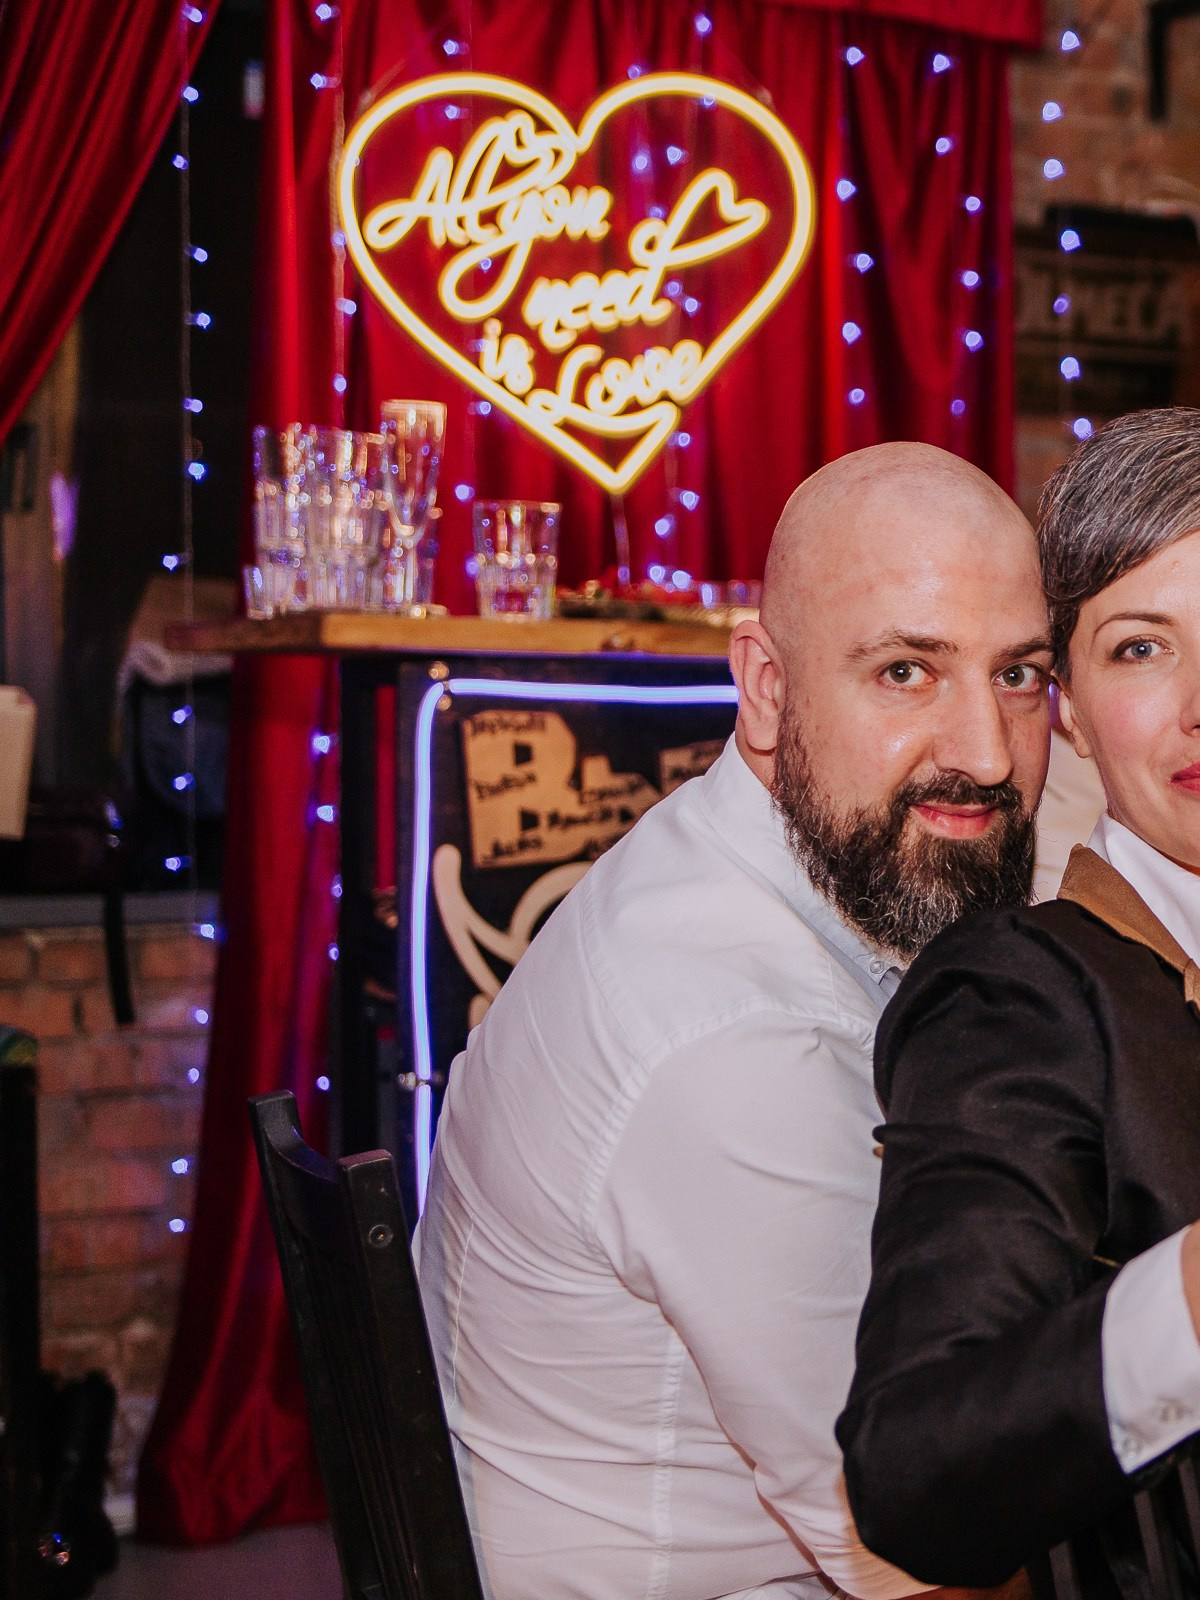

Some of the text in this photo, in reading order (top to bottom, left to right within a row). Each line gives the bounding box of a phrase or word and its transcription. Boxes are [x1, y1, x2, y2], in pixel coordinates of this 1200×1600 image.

[363, 111, 577, 249] All
[439, 186, 613, 320] you
[479, 319, 535, 394] is
